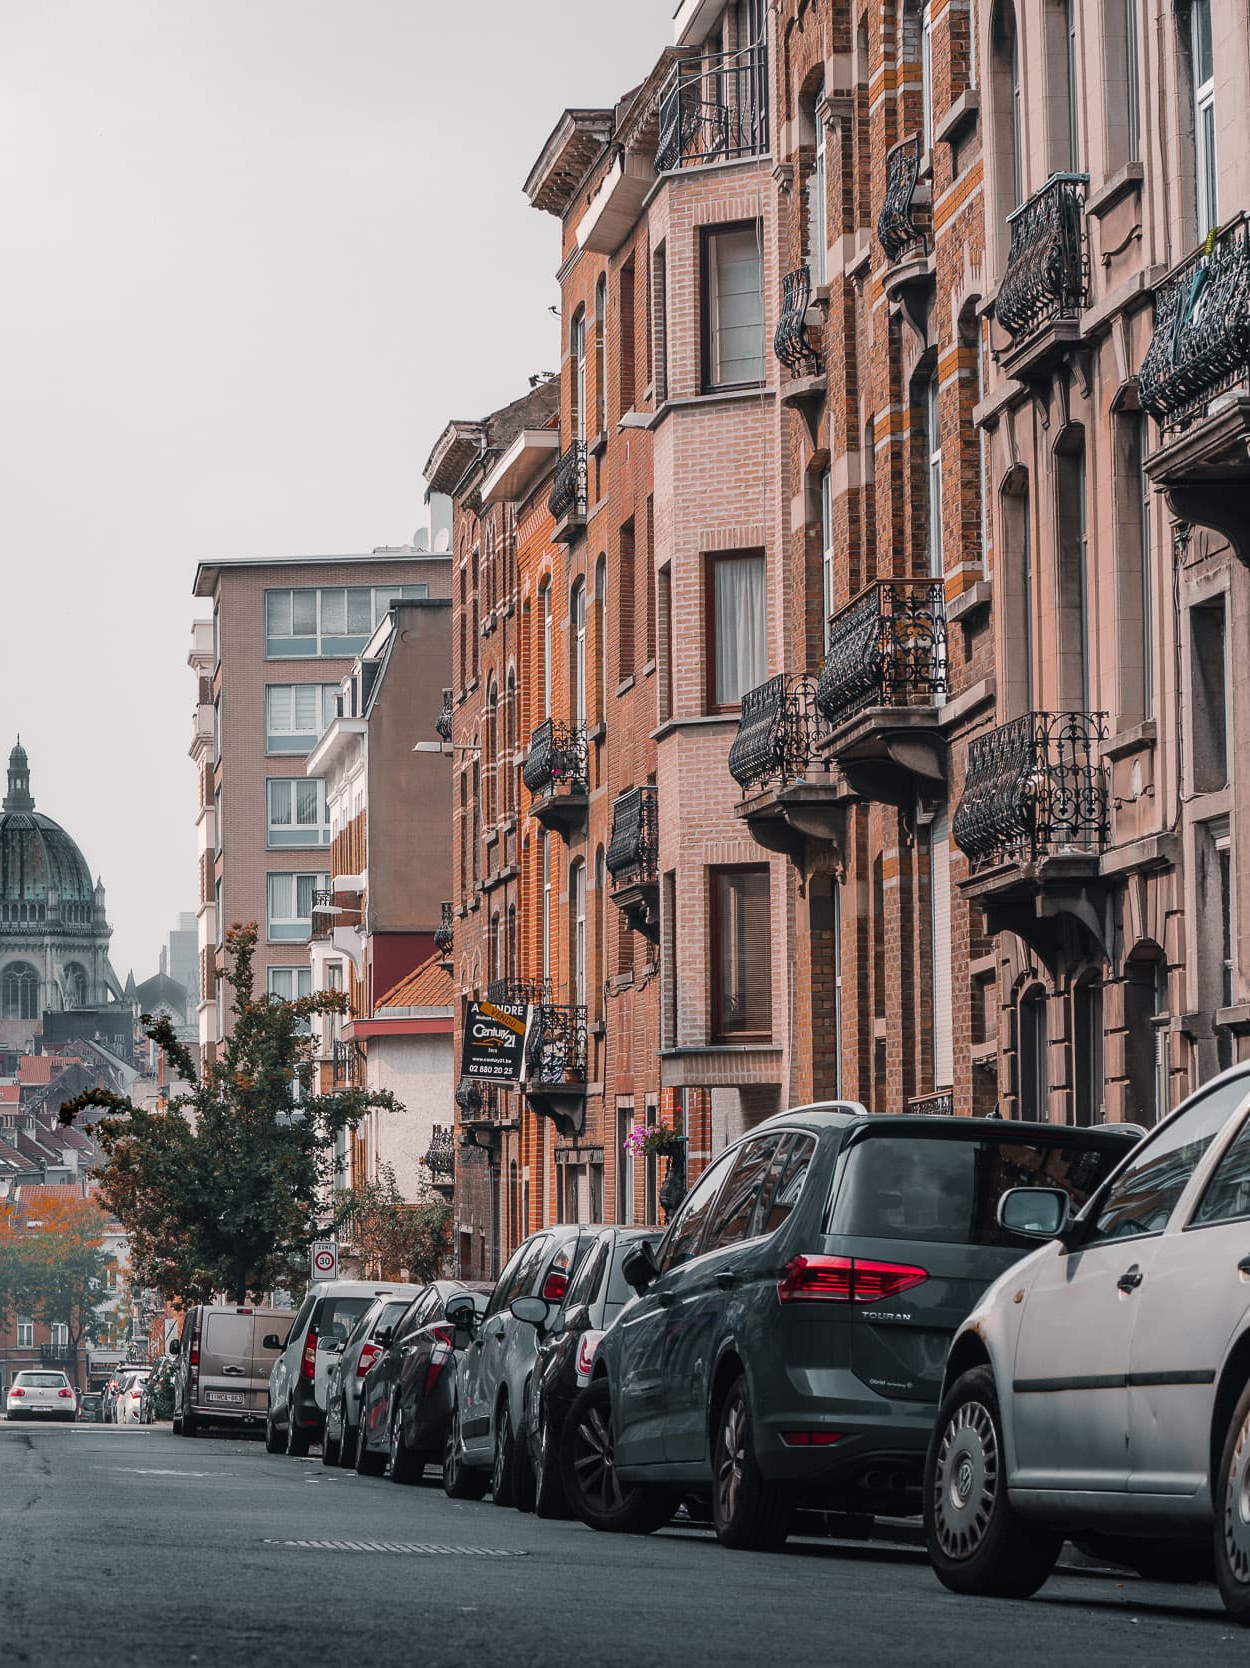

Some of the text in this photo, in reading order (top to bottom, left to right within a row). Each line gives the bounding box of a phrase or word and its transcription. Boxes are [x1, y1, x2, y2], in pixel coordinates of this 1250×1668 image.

[471, 1003, 479, 1013] A
[491, 1008, 516, 1027] VENDU
[473, 1023, 510, 1040] Century
[503, 1035, 516, 1048] 21
[319, 1257, 330, 1265] 30
[861, 1311, 911, 1321] TOURAN
